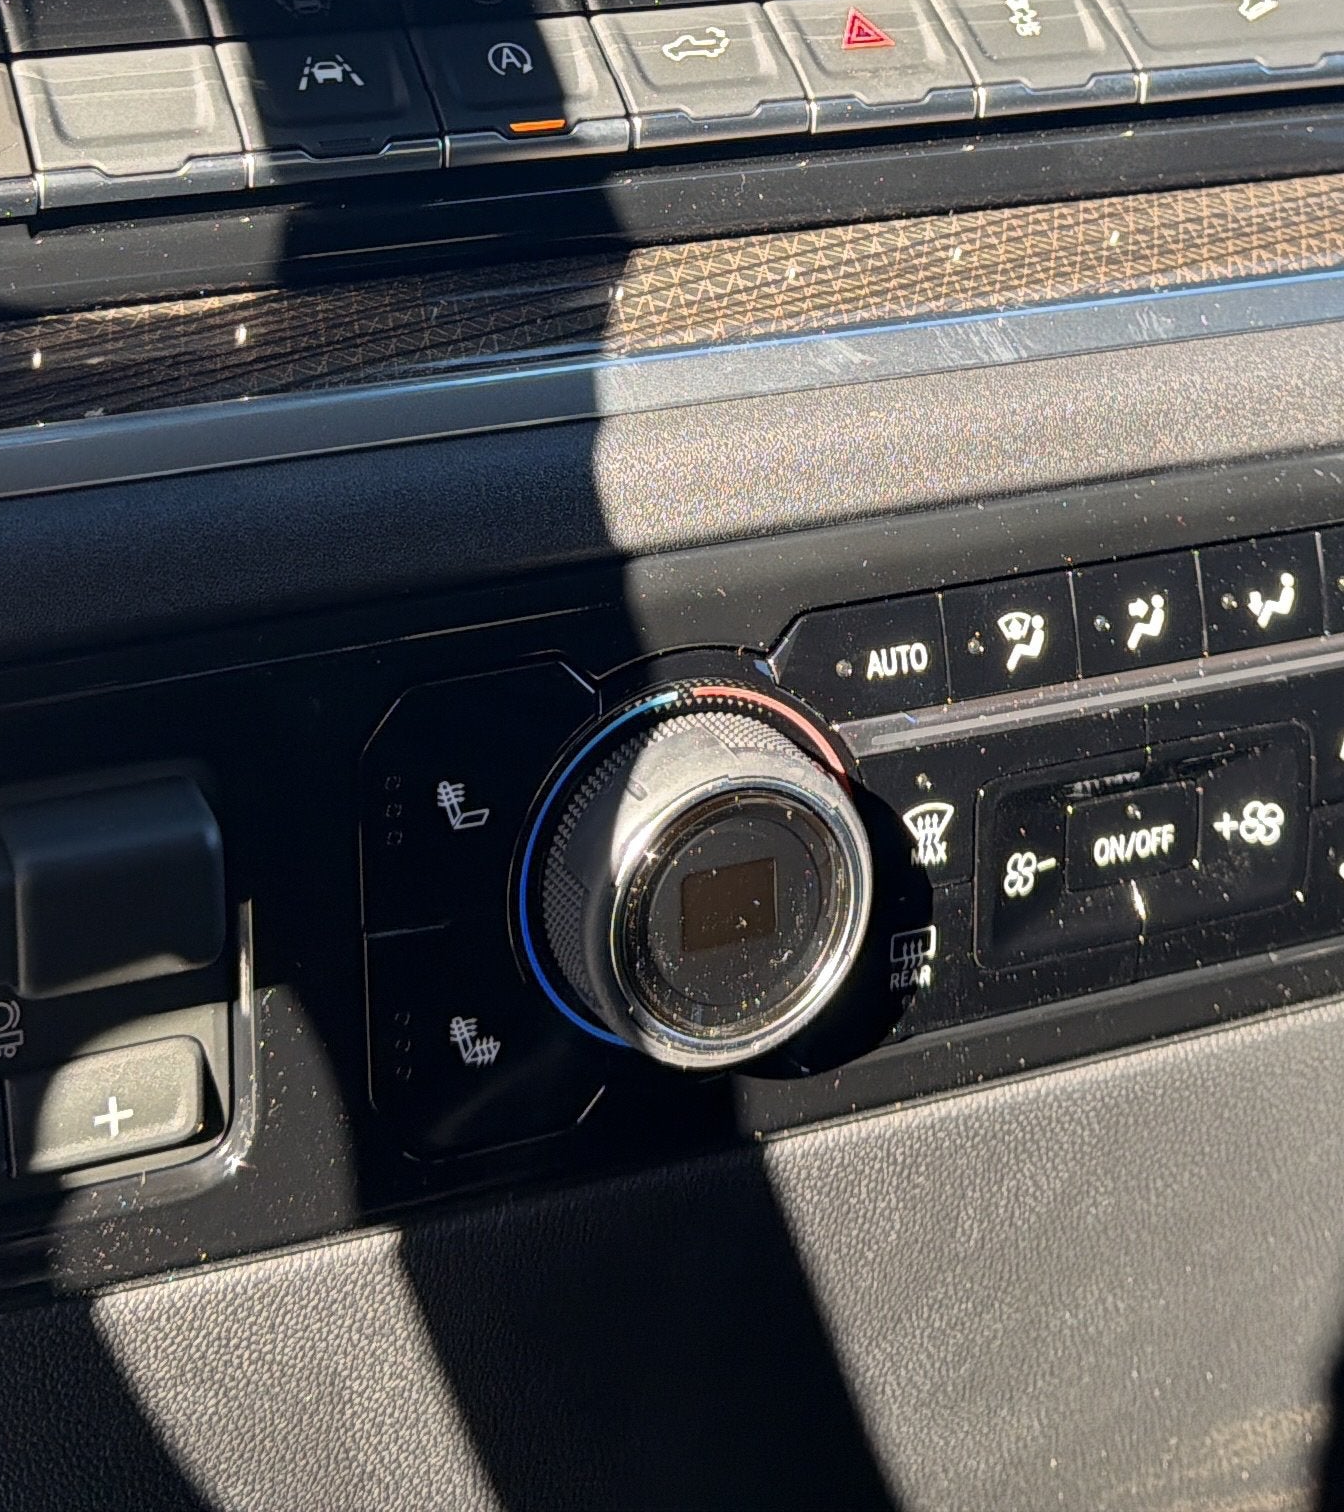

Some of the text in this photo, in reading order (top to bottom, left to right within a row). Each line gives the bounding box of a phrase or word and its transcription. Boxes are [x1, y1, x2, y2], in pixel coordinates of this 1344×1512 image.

[866, 641, 929, 681] AUTO
[910, 840, 948, 866] MAX
[1093, 823, 1176, 867] ON/OFF
[889, 964, 932, 991] REAR
